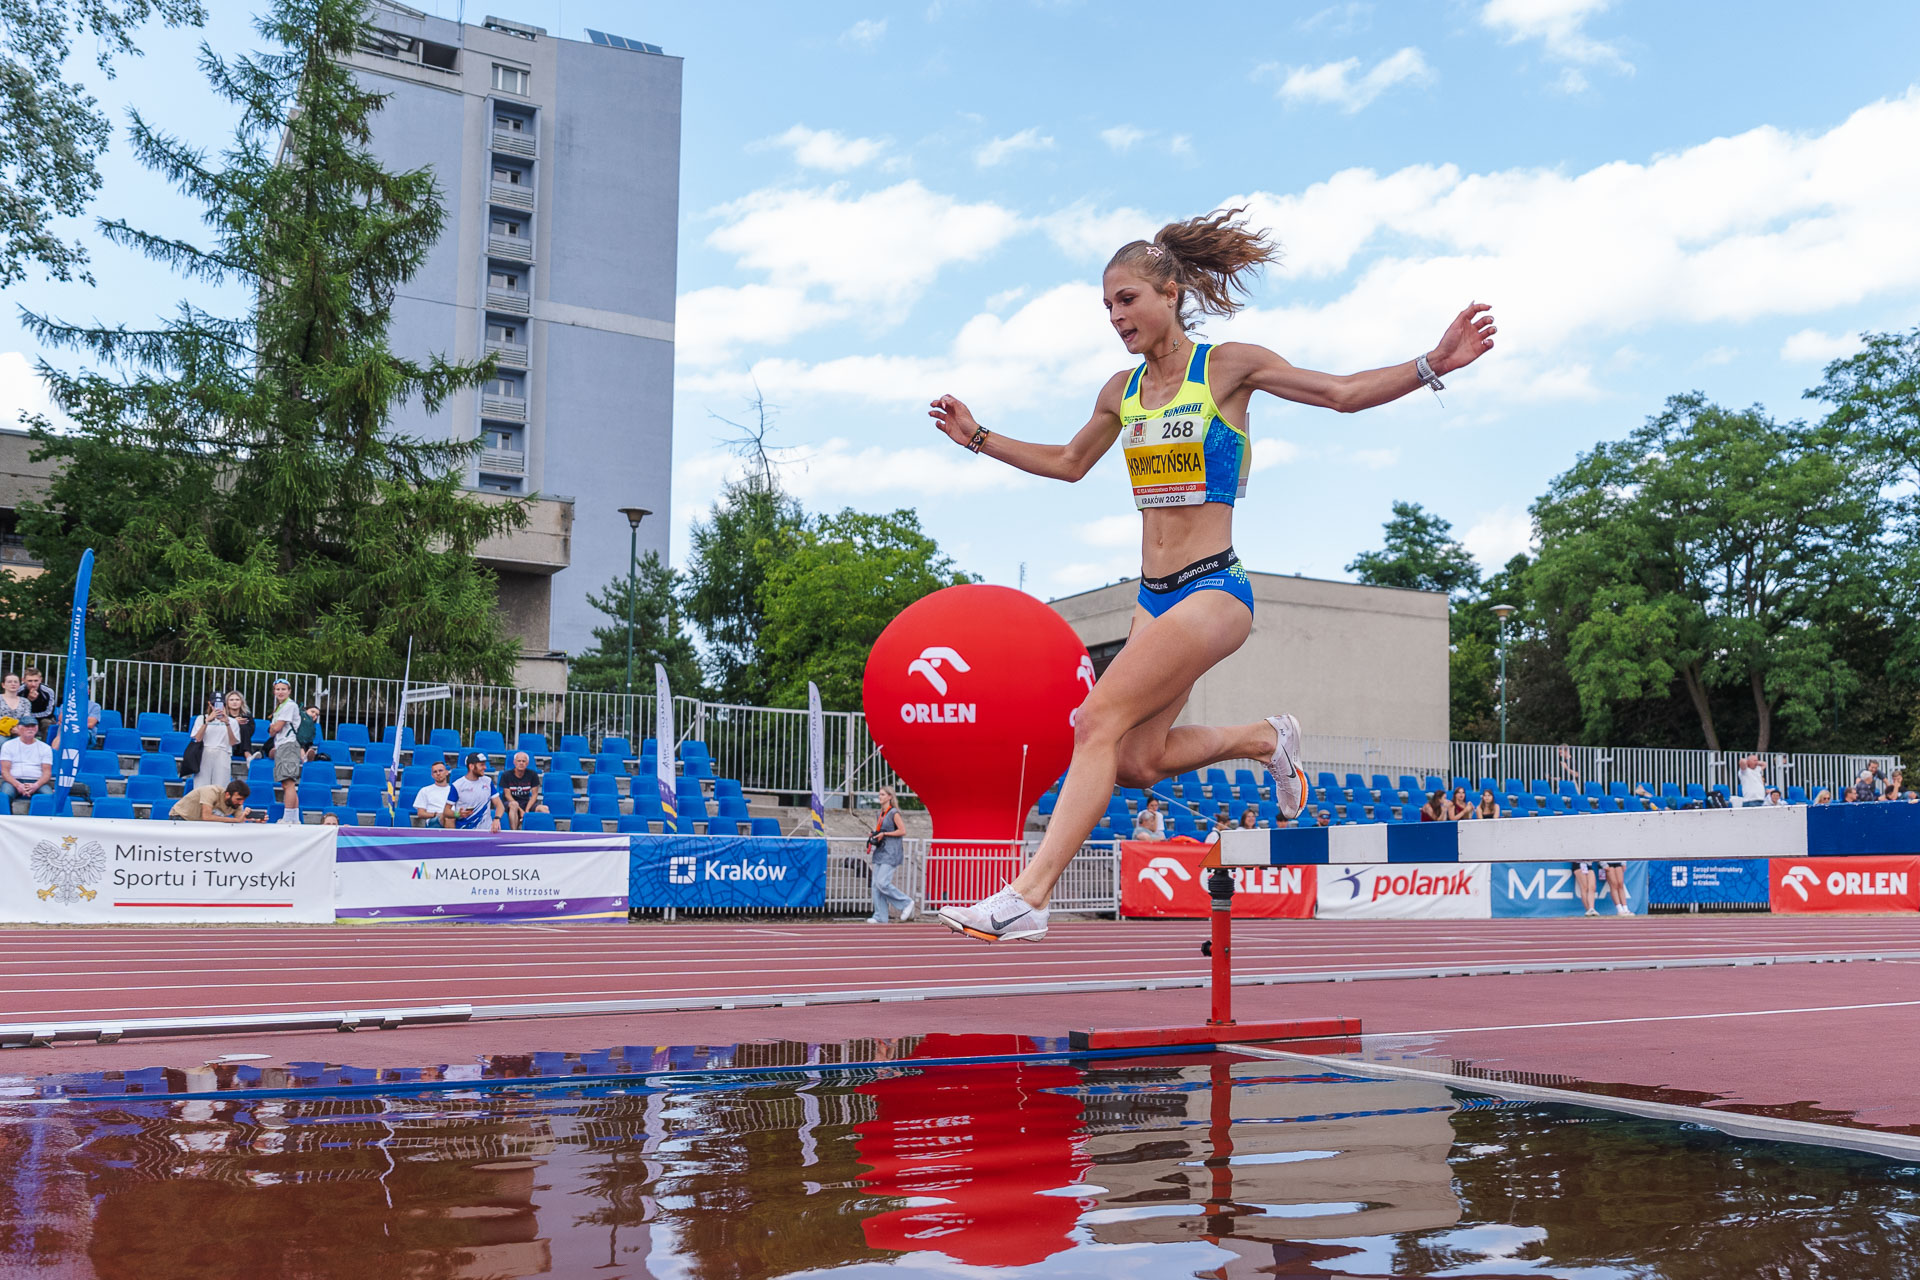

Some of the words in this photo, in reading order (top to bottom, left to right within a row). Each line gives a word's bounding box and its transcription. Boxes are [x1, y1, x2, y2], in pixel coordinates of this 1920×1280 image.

[1162, 421, 1194, 439] 268
[1128, 450, 1202, 477] KRAWCZYŃSKA
[1142, 496, 1164, 505] KRAKÓW
[1165, 495, 1186, 503] 2025
[900, 703, 976, 723] ORLEN
[115, 844, 253, 864] Ministerstwo
[113, 868, 184, 889] Sportu
[192, 870, 197, 886] i
[203, 870, 296, 890] Turystyki
[435, 868, 541, 881] MAŁOPOLSKA
[704, 858, 787, 881] Kraków
[471, 887, 500, 896] Arena
[507, 887, 561, 896] Mistrzostw
[1371, 868, 1473, 903] polanik
[1826, 872, 1908, 895] ORLEN
